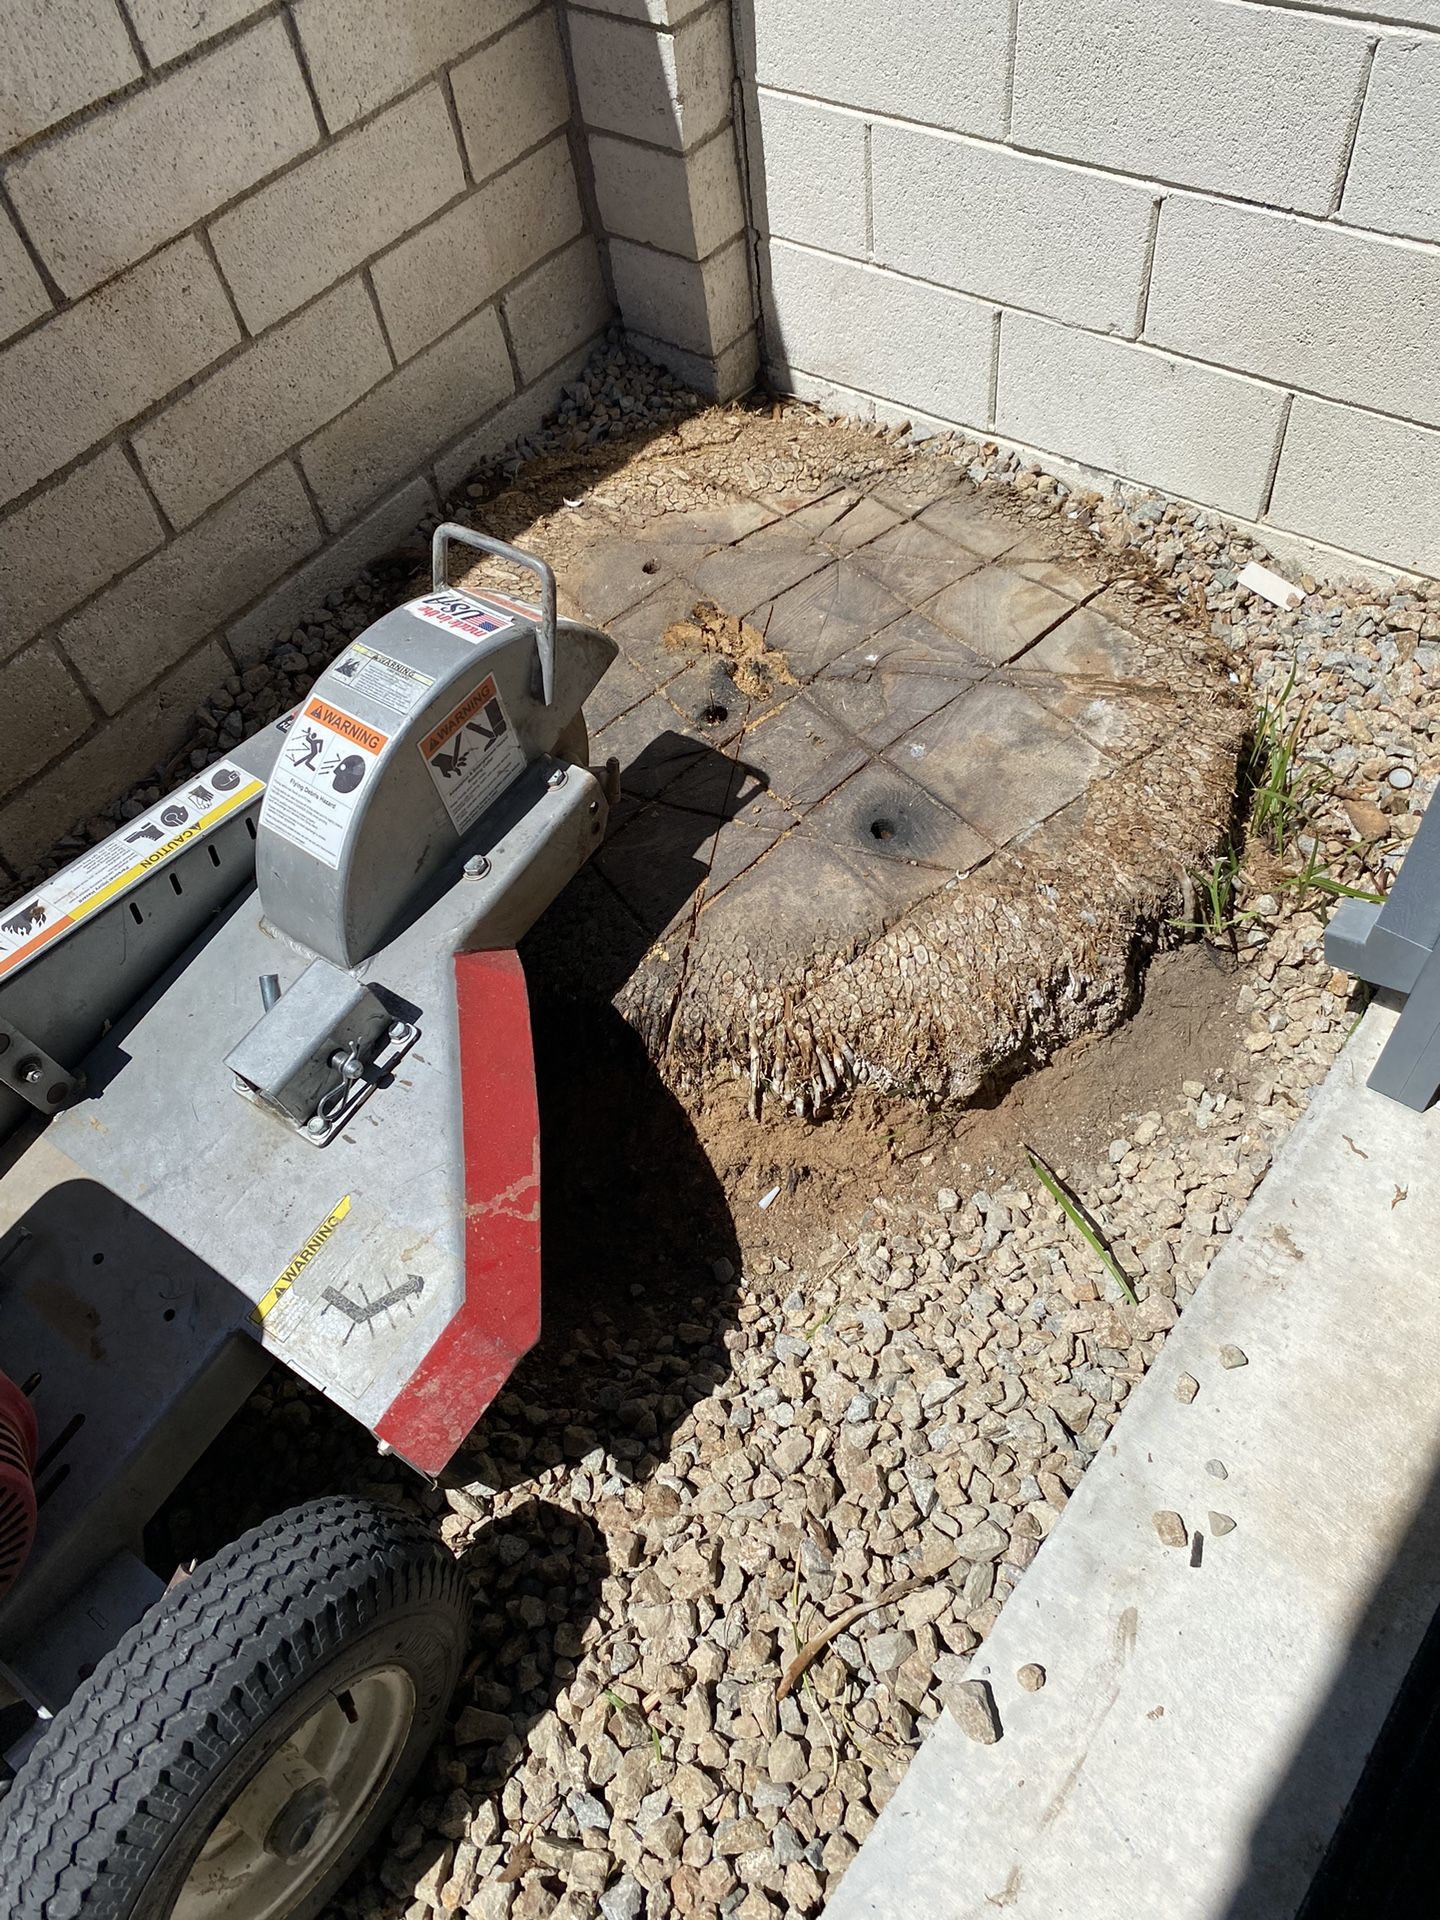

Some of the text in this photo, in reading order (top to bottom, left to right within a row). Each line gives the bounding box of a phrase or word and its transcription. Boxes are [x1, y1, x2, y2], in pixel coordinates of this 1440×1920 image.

[417, 606, 487, 638] made in the
[422, 596, 484, 620] USA
[323, 711, 380, 749] WARNING
[436, 685, 490, 741] WARNING
[290, 778, 336, 809] Flying Debris Hazard
[140, 829, 194, 869] CAUTION
[282, 1216, 338, 1283] WARNING
